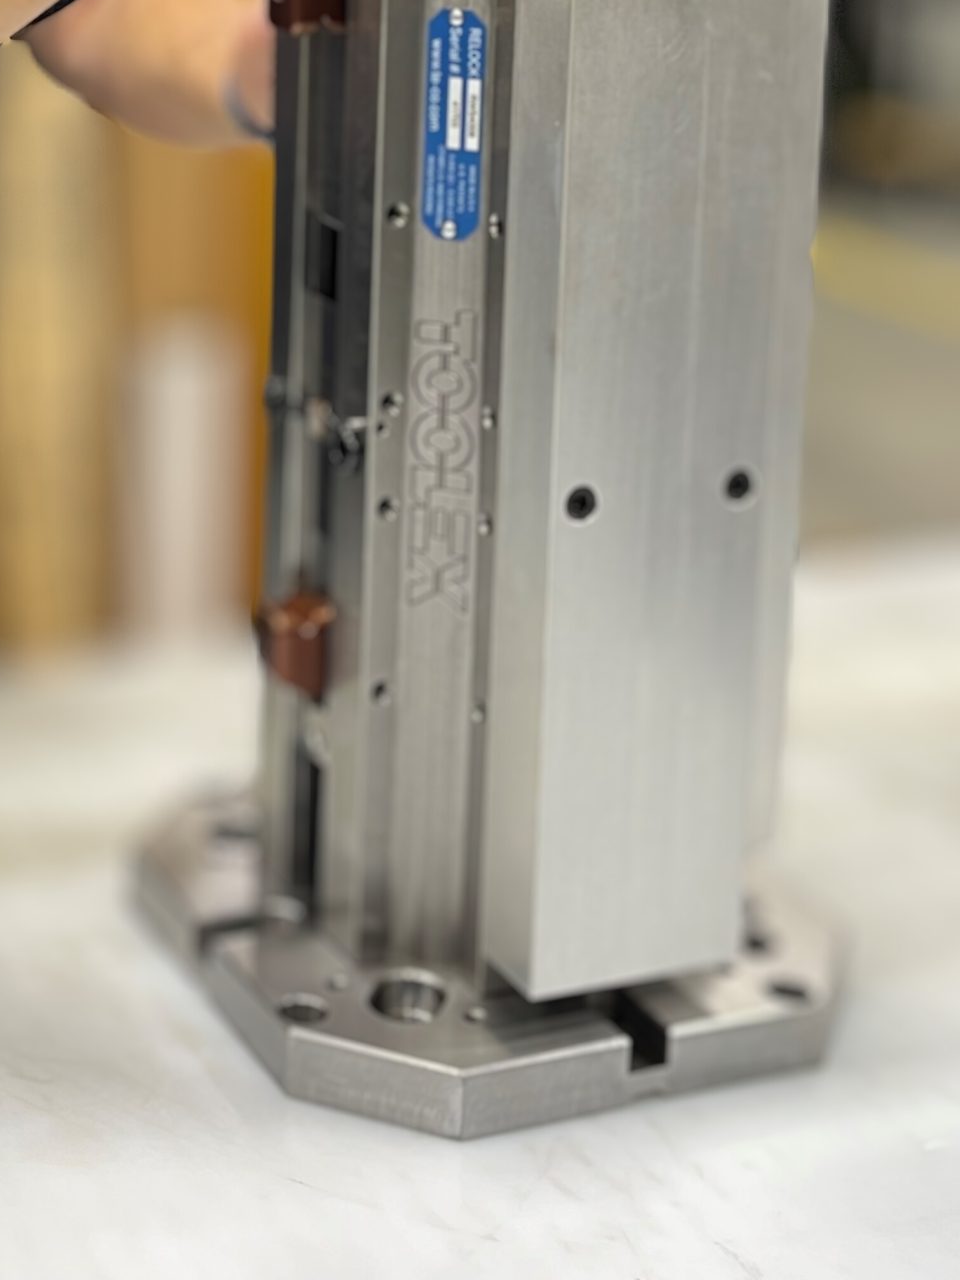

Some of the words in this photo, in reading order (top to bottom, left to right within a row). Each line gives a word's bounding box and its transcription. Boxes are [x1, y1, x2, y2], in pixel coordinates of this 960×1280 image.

[448, 26, 463, 62] Serial
[467, 27, 482, 78] RELOCK
[407, 308, 479, 615] TOOLEX
